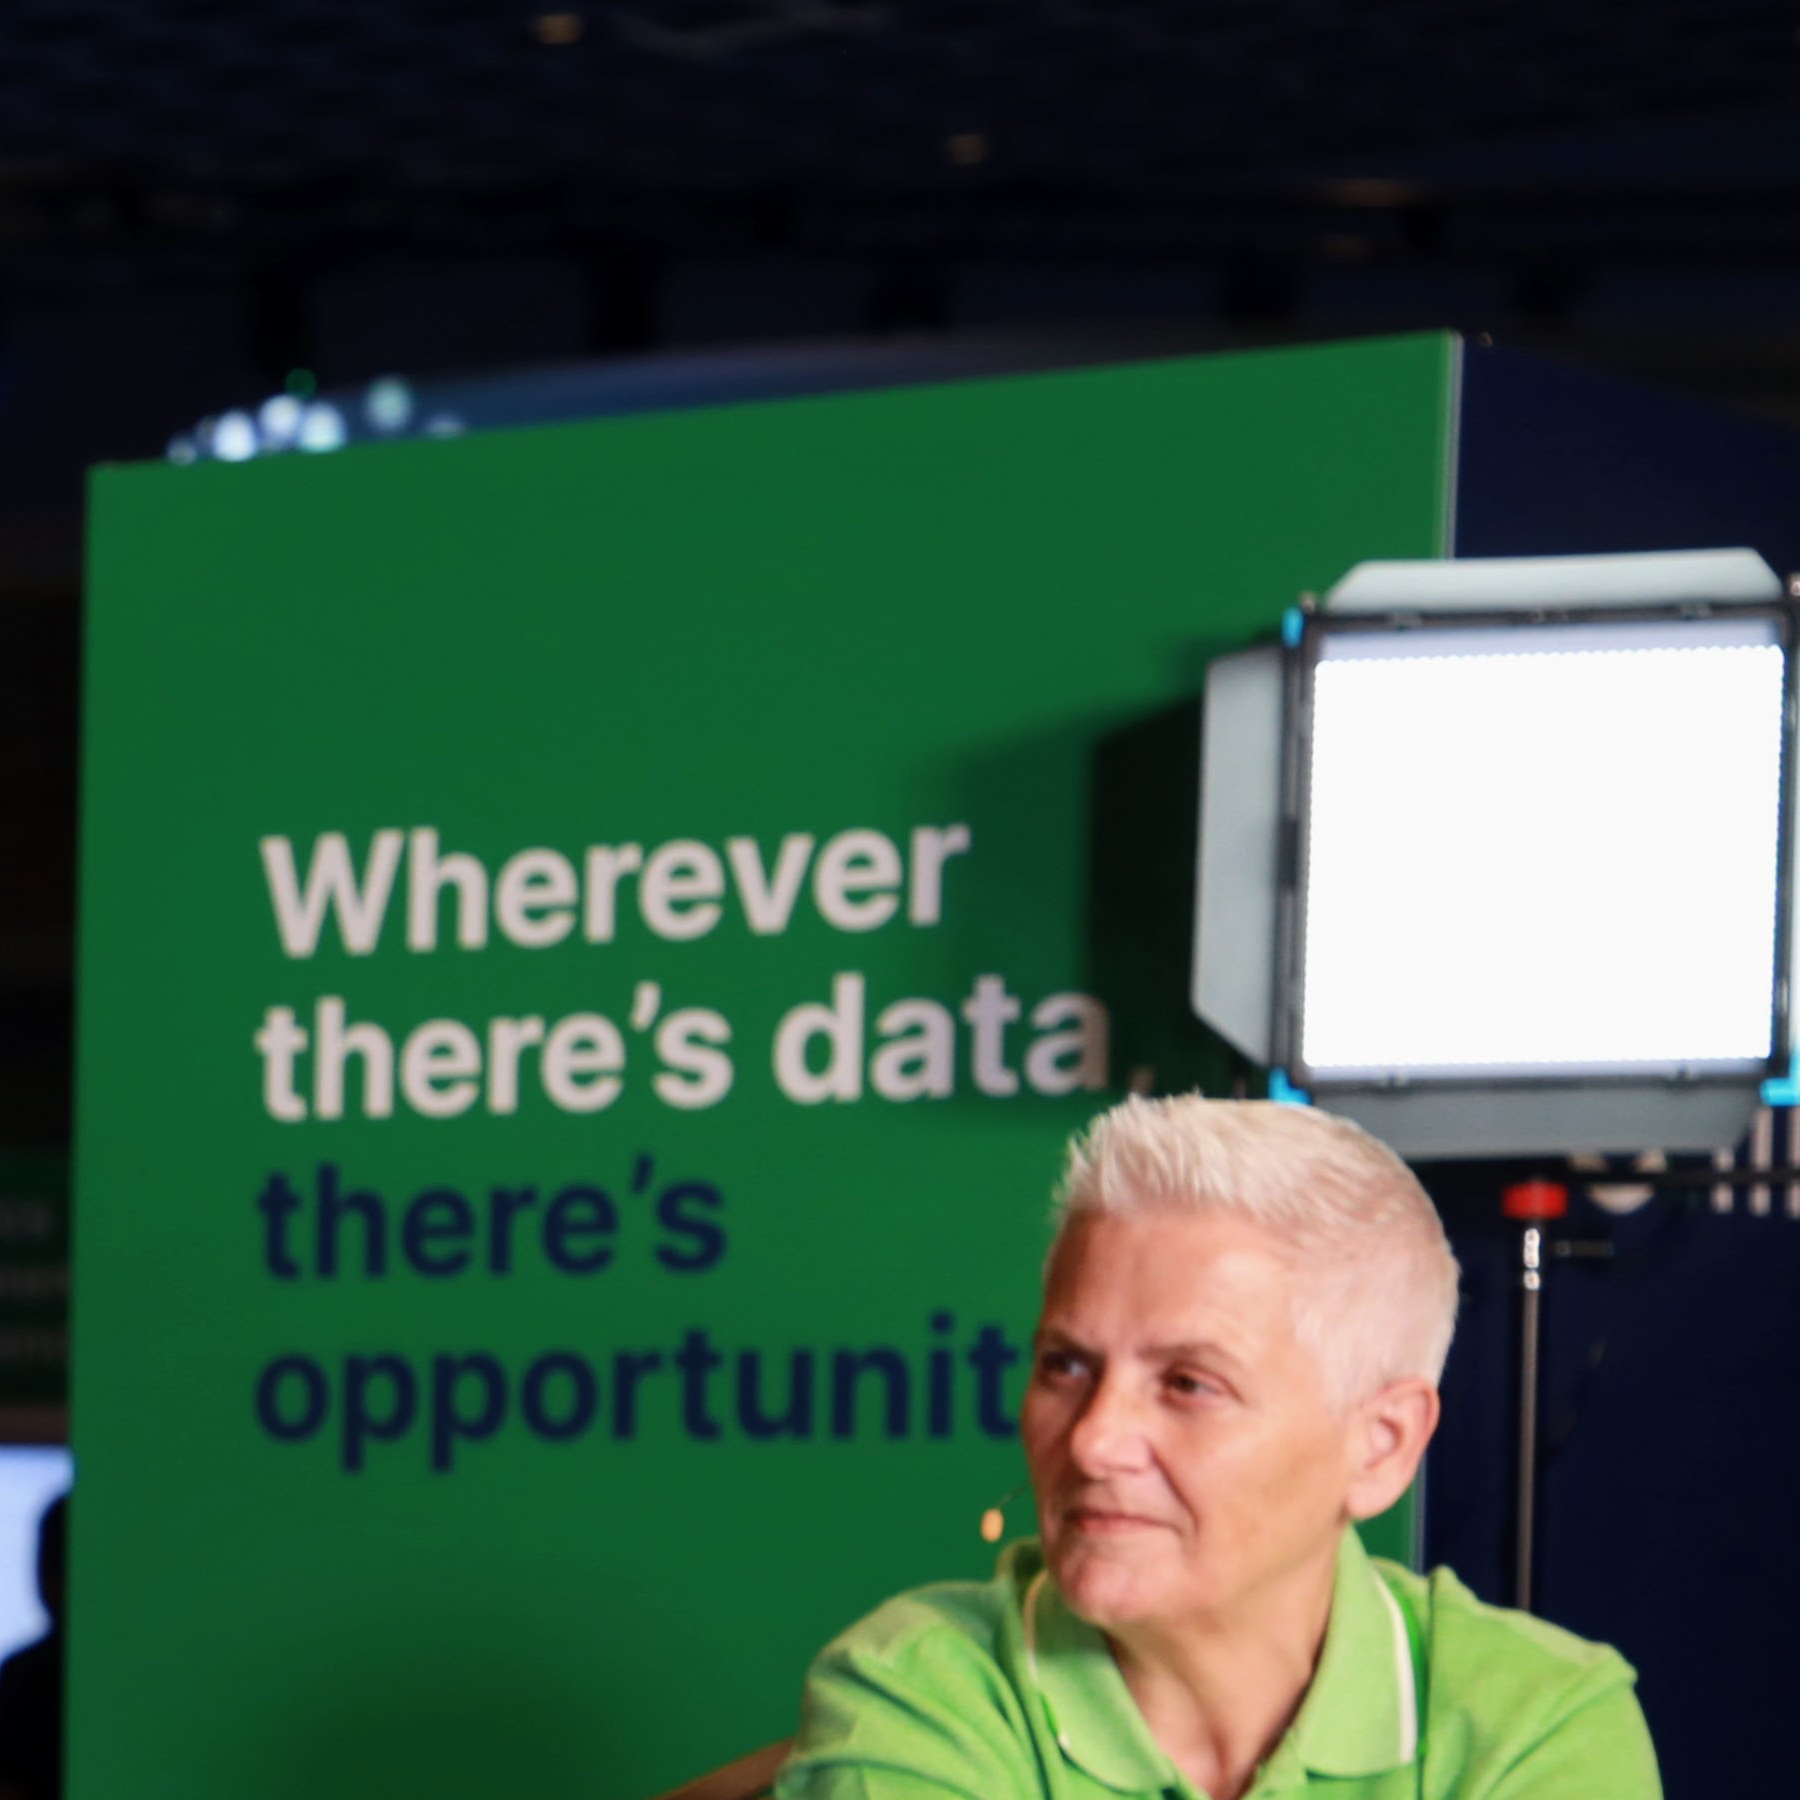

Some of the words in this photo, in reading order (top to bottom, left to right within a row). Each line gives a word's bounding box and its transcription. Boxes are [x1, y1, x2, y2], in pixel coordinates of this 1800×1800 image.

[260, 824, 970, 959] Wherever
[254, 981, 735, 1123] there’s
[256, 1151, 730, 1284] there’s
[252, 1309, 1021, 1475] opportunit
